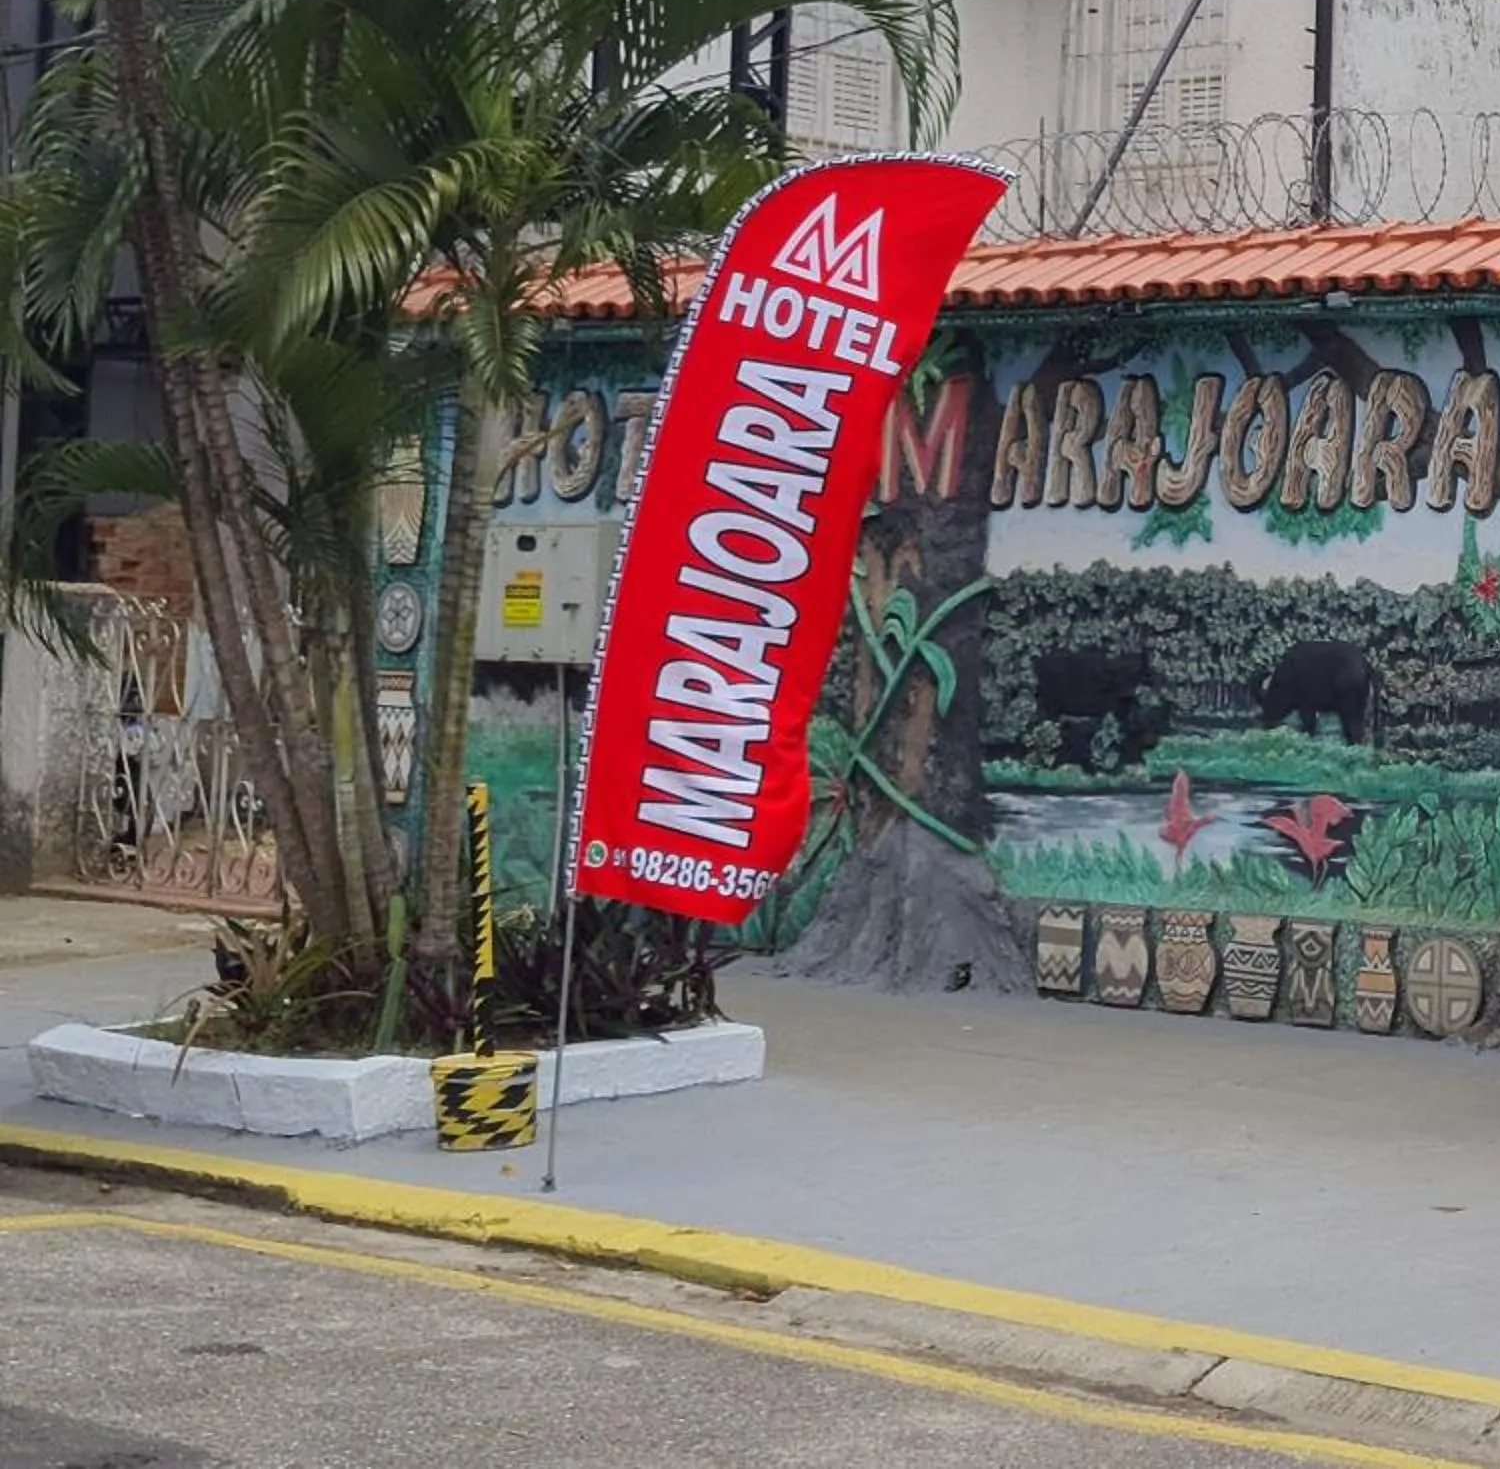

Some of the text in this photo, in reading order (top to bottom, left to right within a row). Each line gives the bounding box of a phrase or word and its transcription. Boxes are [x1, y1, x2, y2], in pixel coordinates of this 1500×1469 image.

[719, 271, 902, 376] HOTEL
[493, 390, 660, 506] HOT
[637, 359, 852, 849] MARAJOARA
